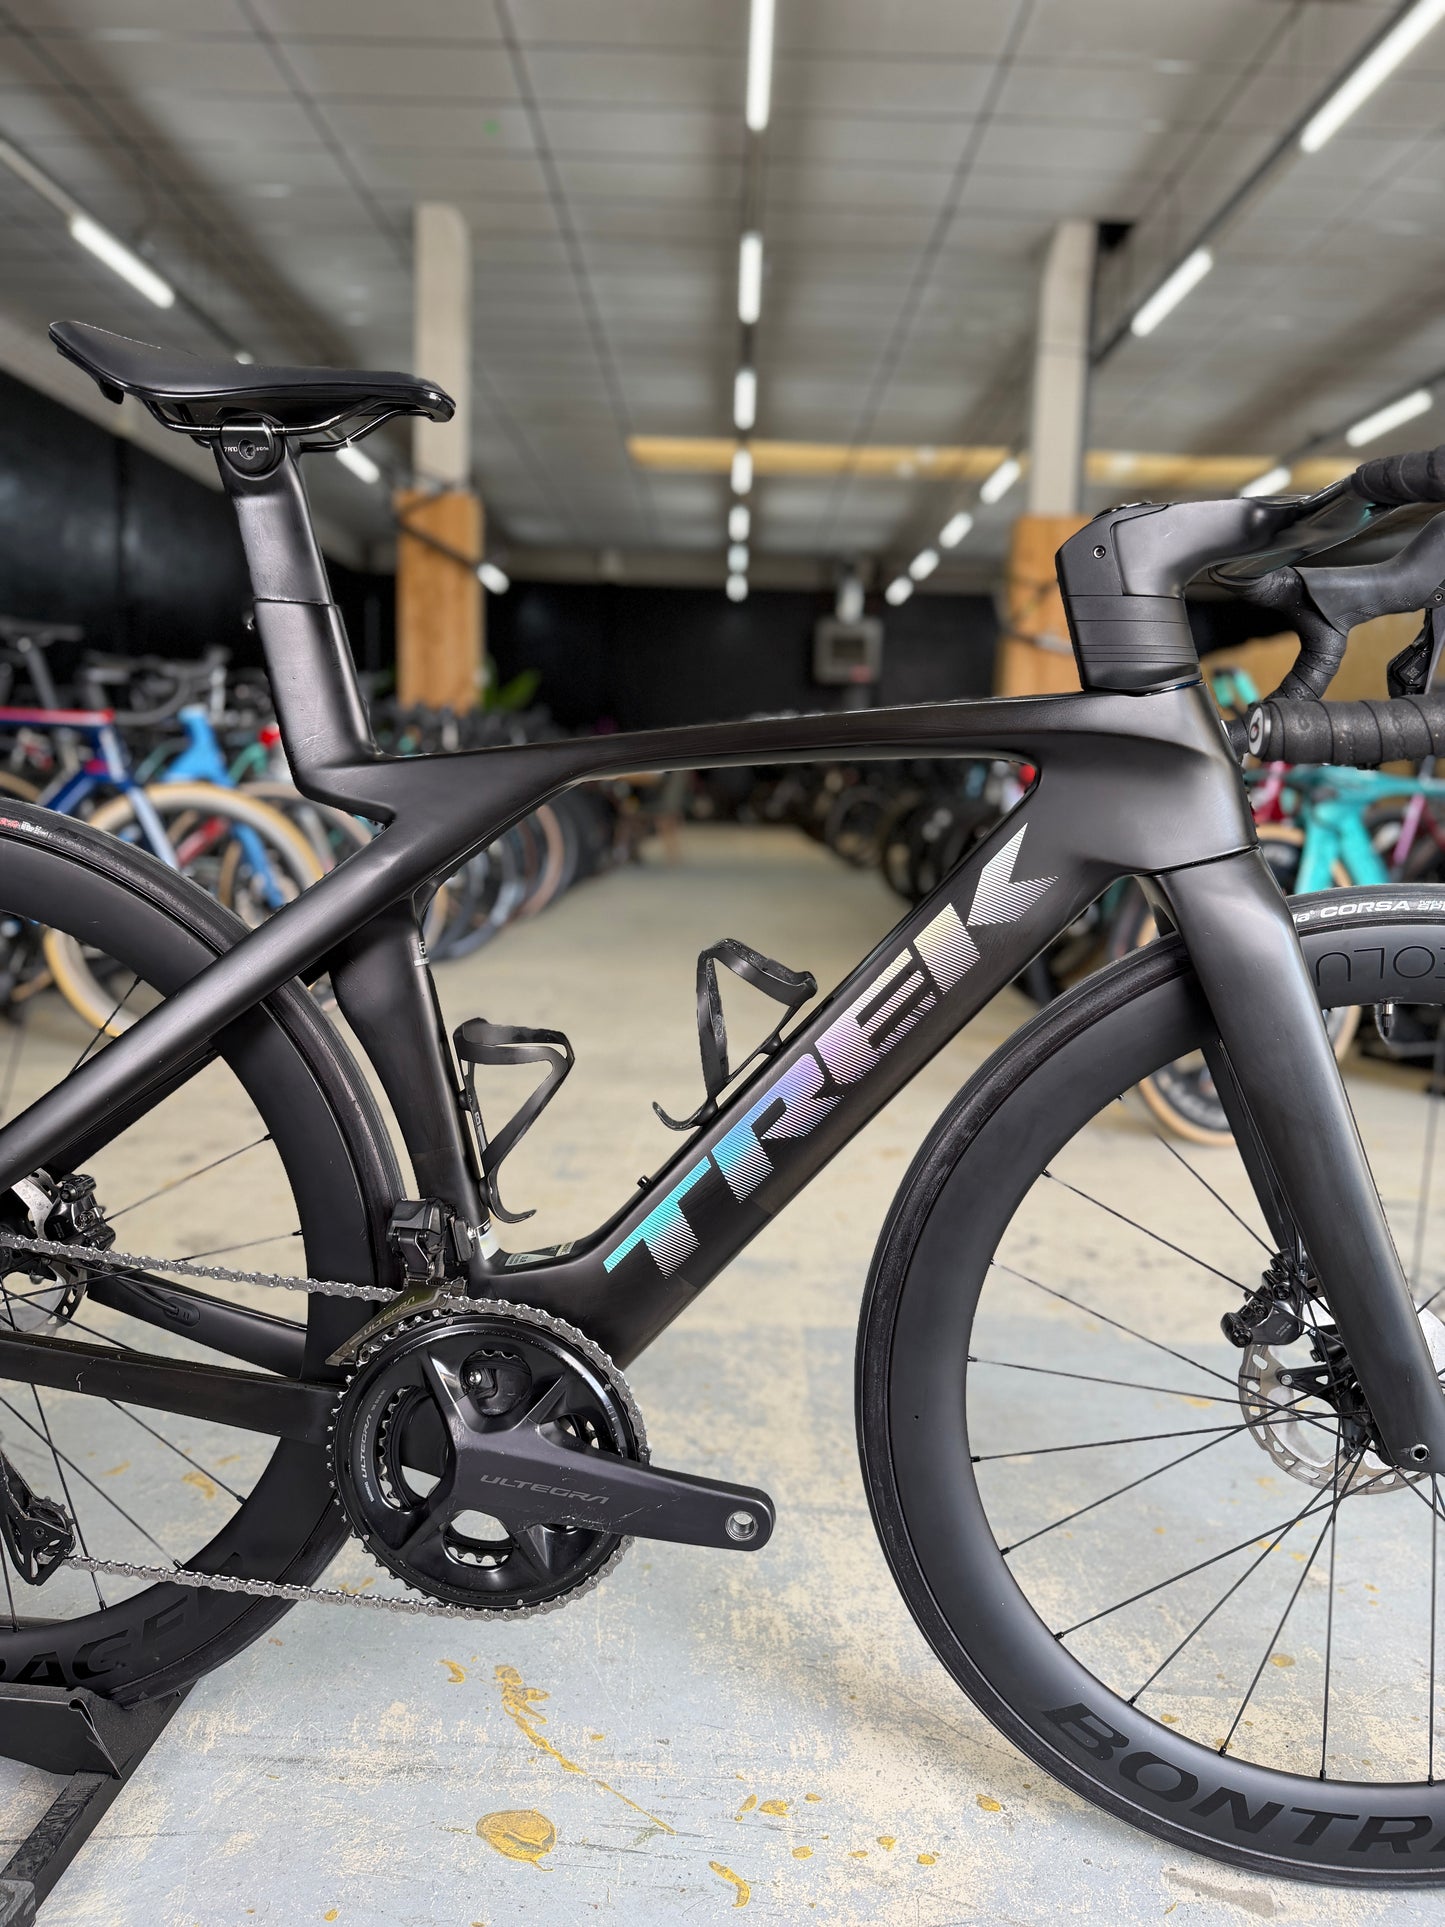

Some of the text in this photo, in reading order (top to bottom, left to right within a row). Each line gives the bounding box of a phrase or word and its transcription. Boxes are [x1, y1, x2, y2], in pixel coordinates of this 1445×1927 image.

[1320, 900, 1410, 918] CORSA
[603, 822, 1059, 1279] TREK
[480, 1474, 610, 1504] ULTEGRA
